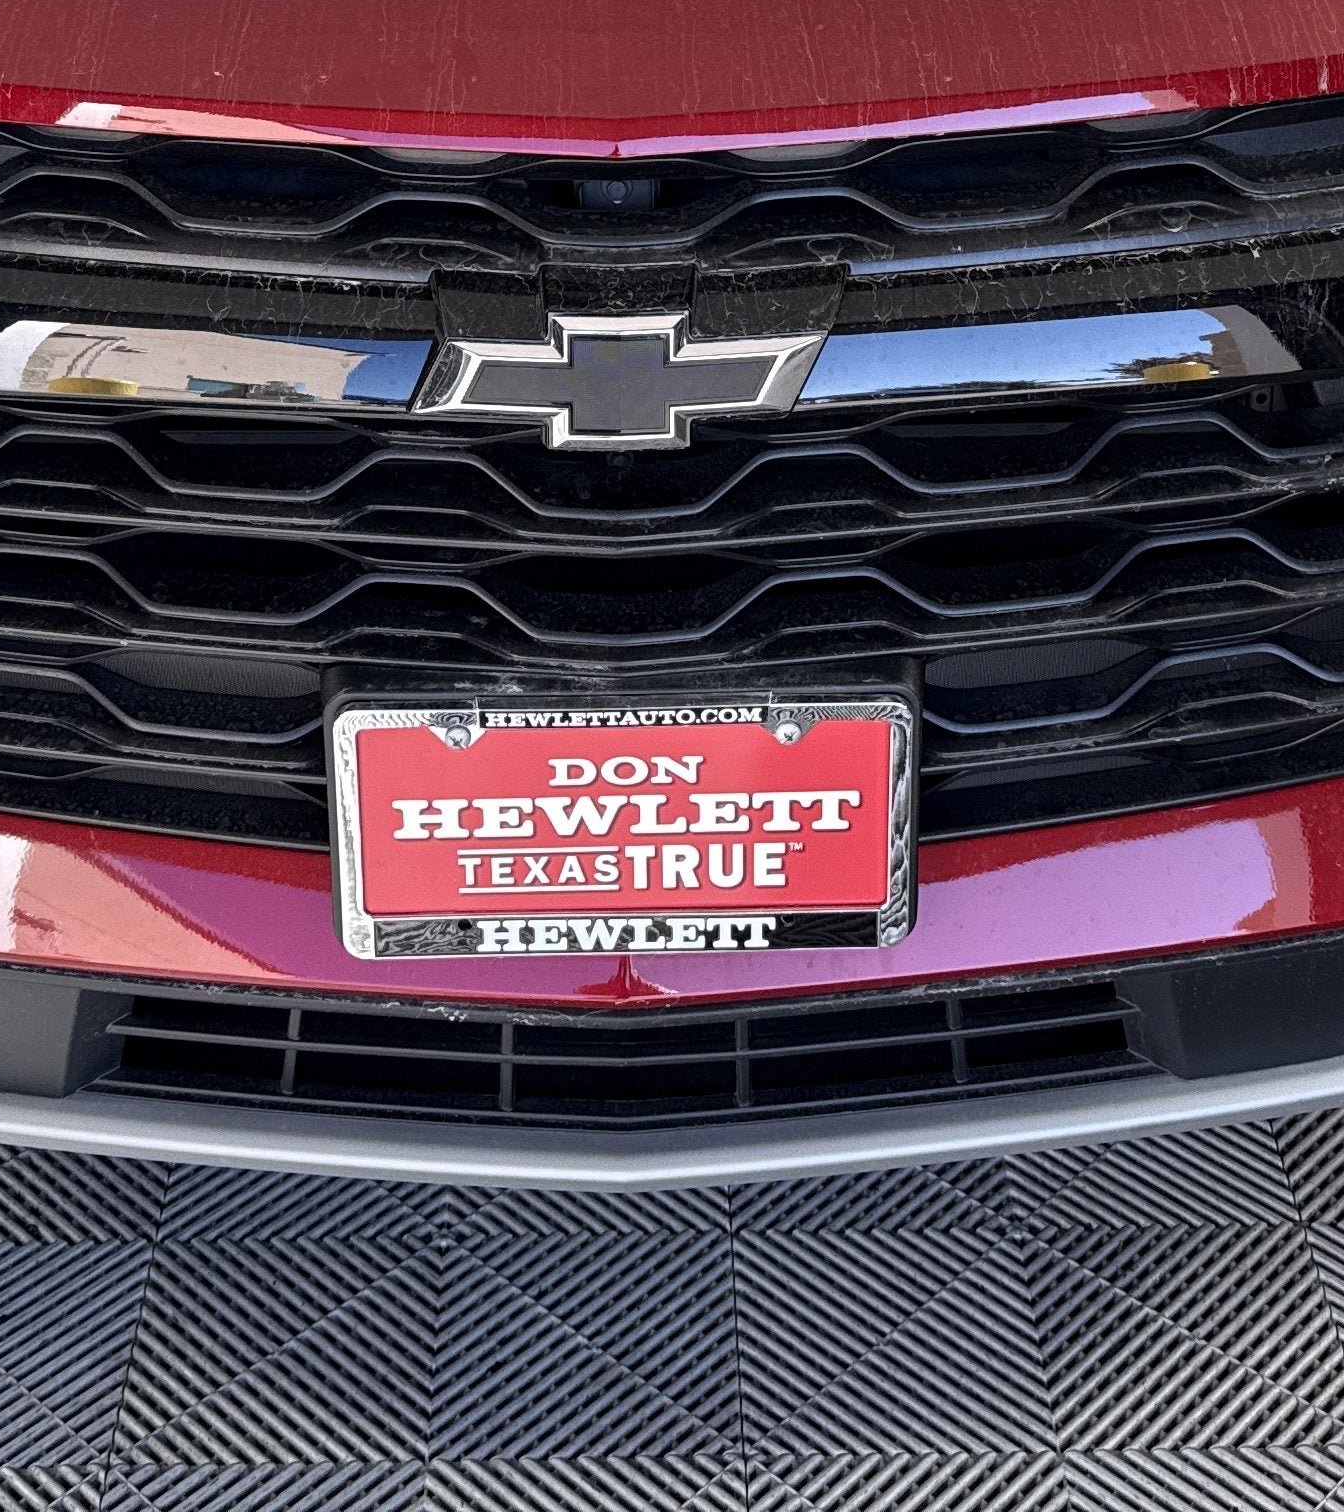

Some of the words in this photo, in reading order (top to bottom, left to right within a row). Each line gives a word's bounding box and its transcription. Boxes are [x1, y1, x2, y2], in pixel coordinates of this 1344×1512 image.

[484, 707, 763, 728] HEWLETTAUTO.COM
[547, 755, 704, 787] DON
[391, 789, 861, 841] HEWLETT
[476, 916, 777, 952] HEWLETT
